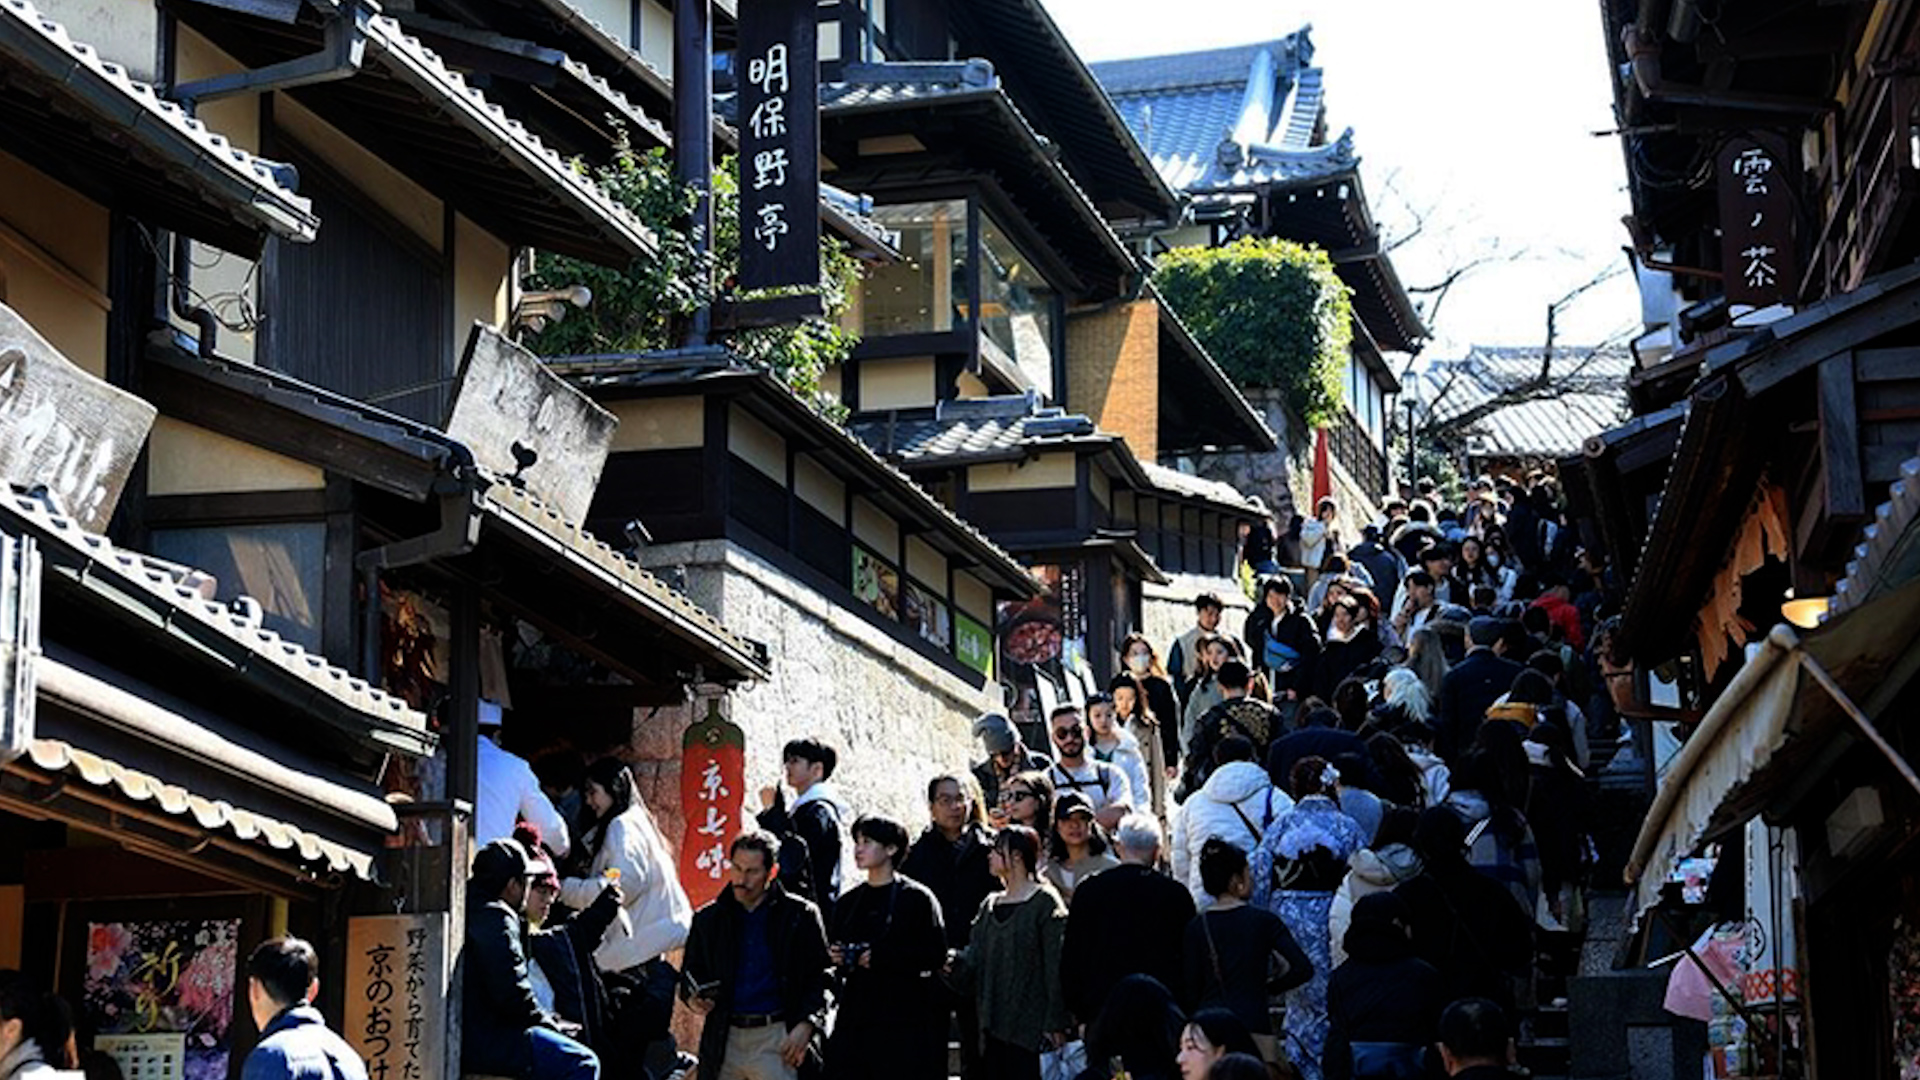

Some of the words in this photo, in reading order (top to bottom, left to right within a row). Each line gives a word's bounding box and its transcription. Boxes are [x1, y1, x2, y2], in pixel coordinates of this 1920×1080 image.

[748, 43, 789, 251] 明保野亭
[1733, 149, 1777, 287] 雲ノ茶
[696, 759, 732, 879] 京七味
[364, 943, 395, 1080] 京のおつけ
[404, 928, 427, 1079] 野菜から育てた
